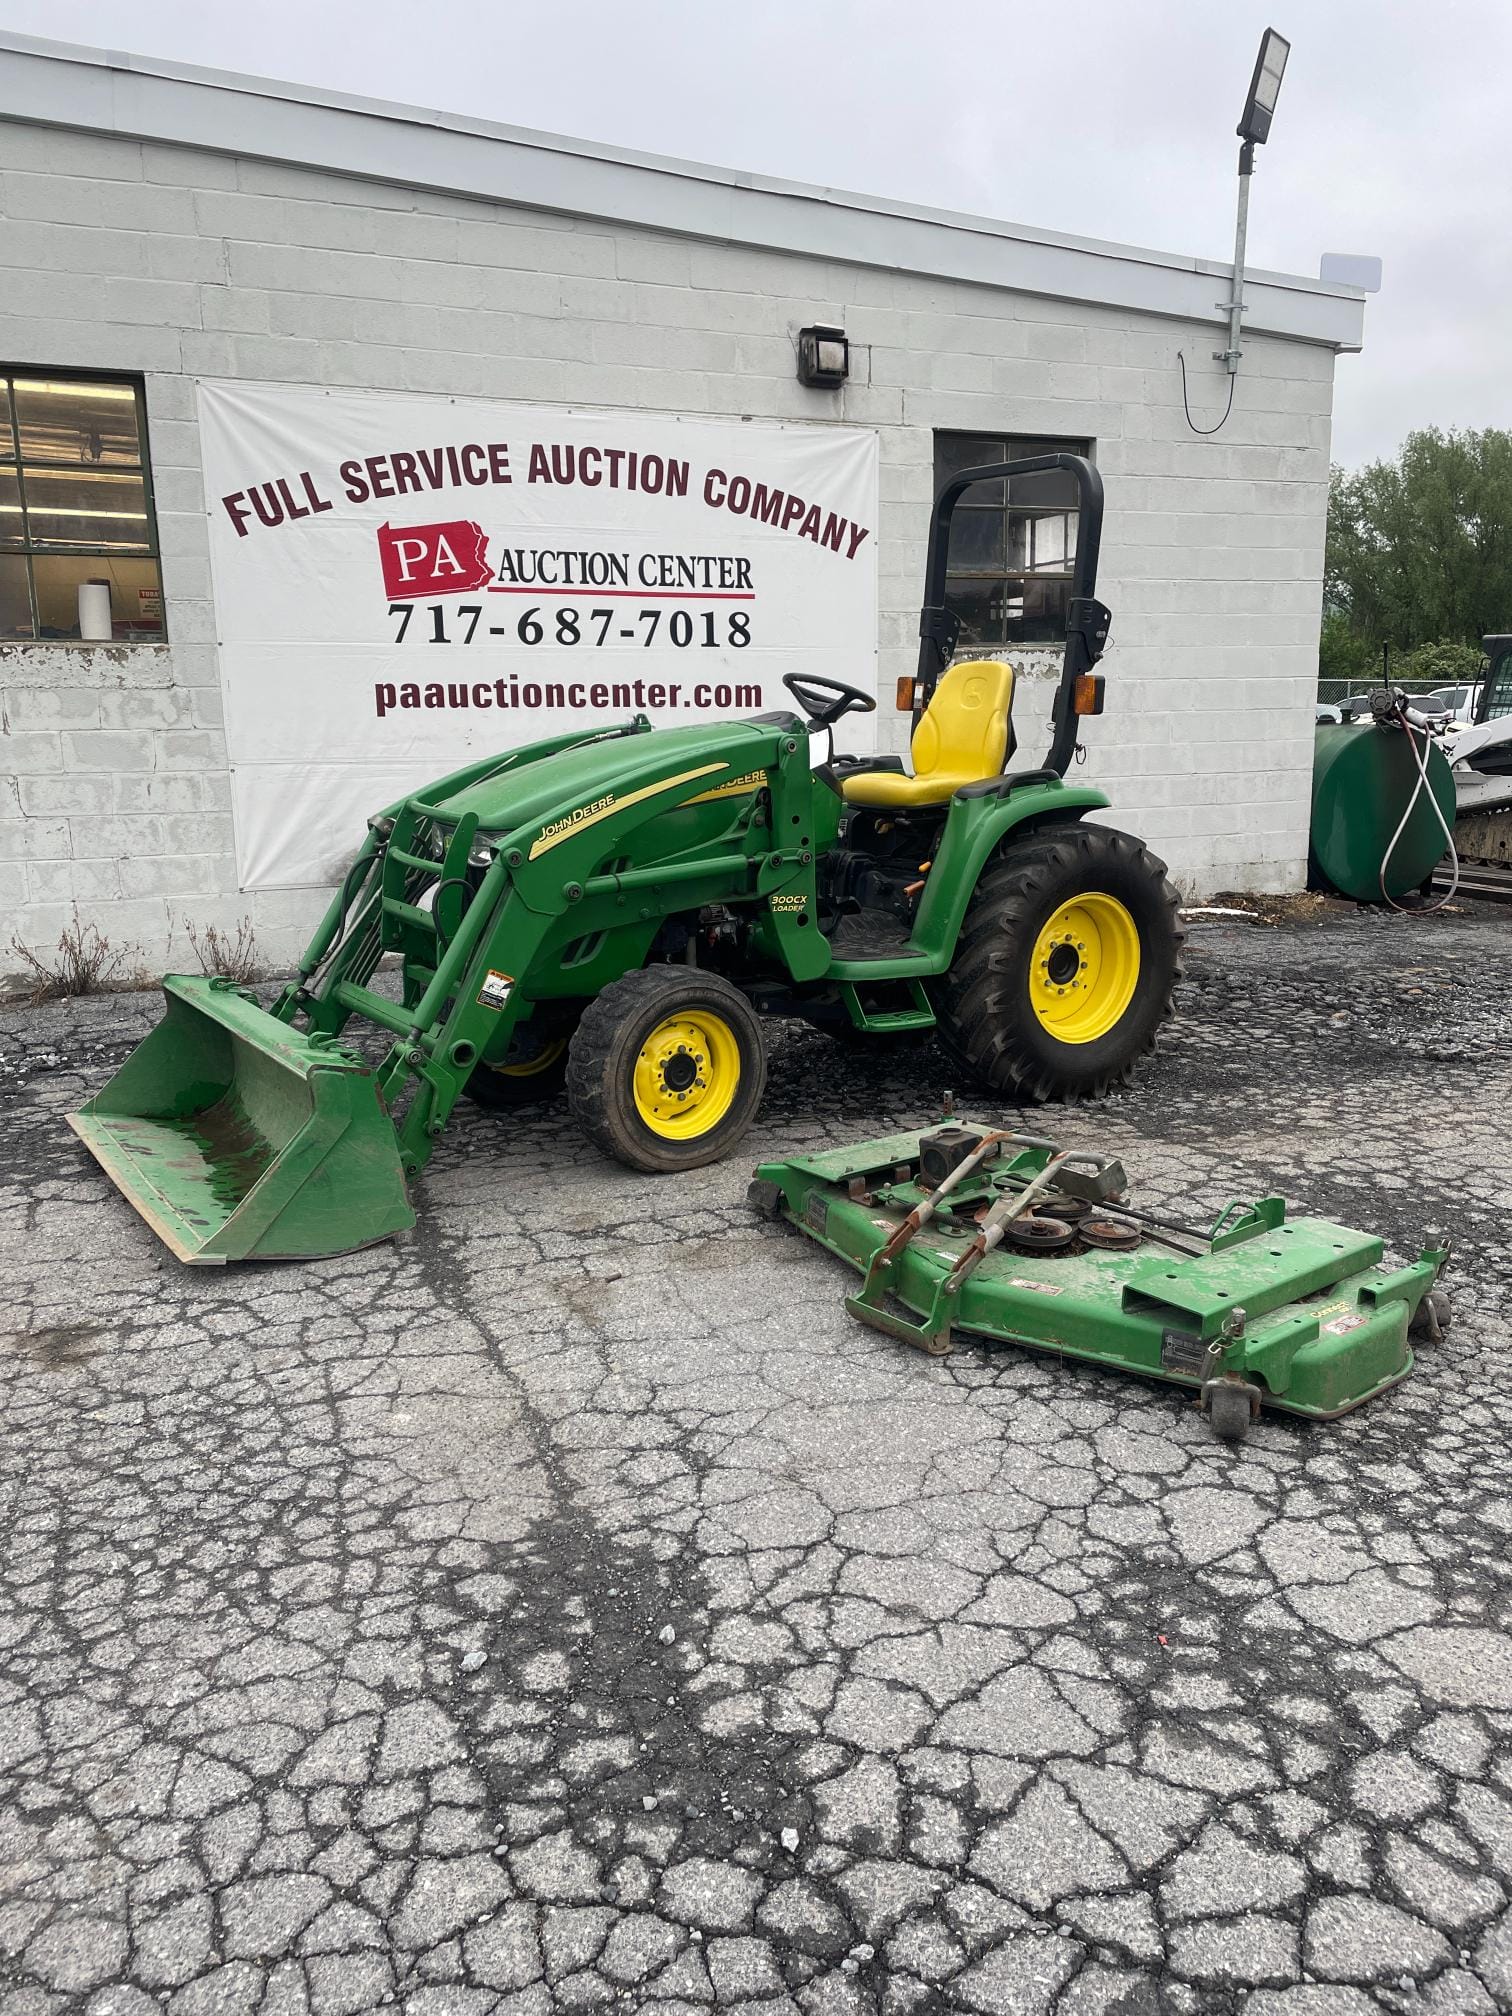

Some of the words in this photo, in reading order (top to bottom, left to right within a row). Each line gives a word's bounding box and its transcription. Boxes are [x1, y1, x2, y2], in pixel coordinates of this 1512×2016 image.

[222, 471, 333, 538] FULL
[339, 443, 513, 504] SERVICE
[527, 443, 690, 497] AUCTION
[703, 468, 870, 561] COMPANY
[391, 533, 468, 582] PA
[497, 548, 630, 587] AUCTION
[638, 553, 754, 590] CENTER
[387, 603, 752, 648] 717-687-7018
[374, 673, 763, 718] paauctioncenter.com
[538, 815, 573, 841] JOHN
[572, 793, 616, 823] DEERE
[771, 895, 808, 904] 300CX
